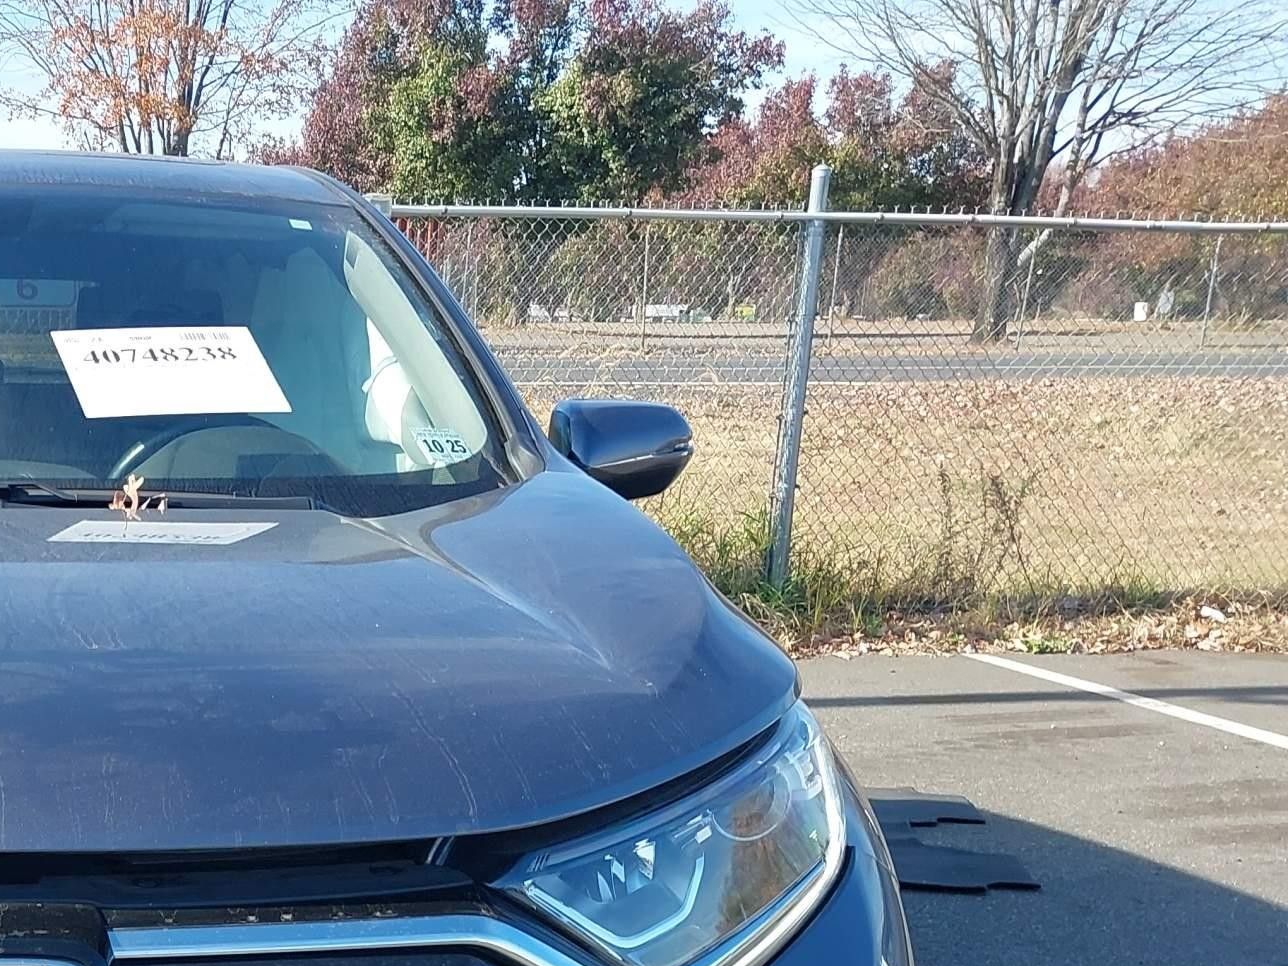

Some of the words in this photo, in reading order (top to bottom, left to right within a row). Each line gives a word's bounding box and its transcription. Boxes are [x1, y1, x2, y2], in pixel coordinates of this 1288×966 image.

[83, 347, 237, 363] 40748238
[422, 439, 444, 453] 10
[446, 439, 467, 453] 25
